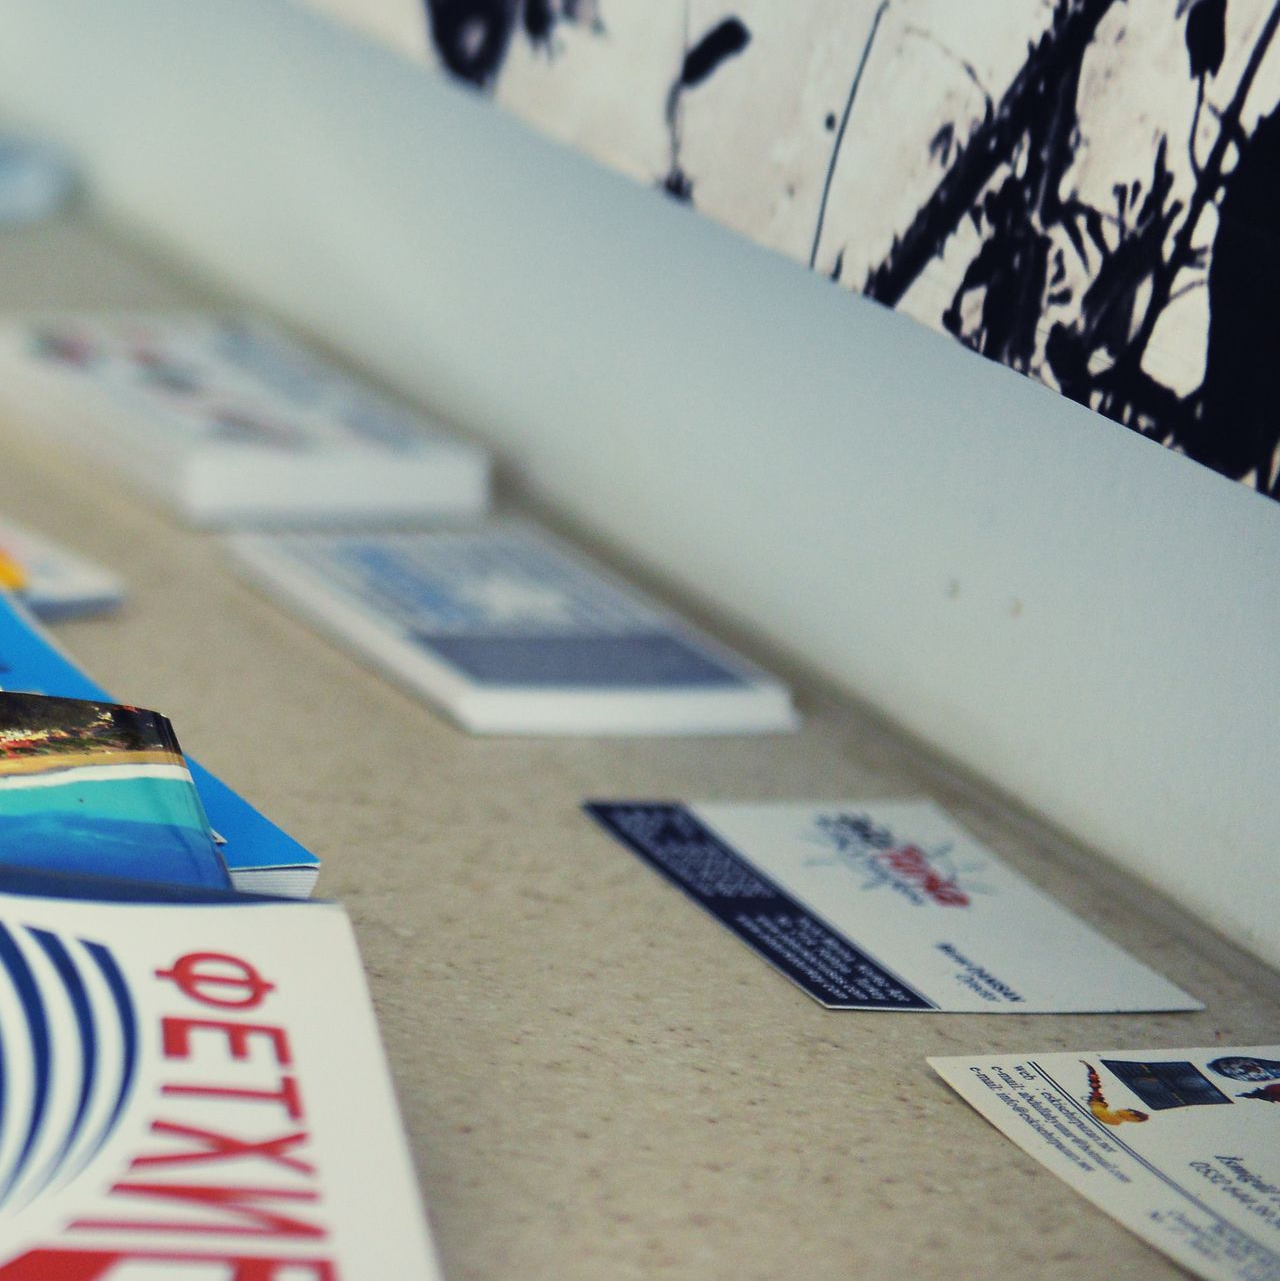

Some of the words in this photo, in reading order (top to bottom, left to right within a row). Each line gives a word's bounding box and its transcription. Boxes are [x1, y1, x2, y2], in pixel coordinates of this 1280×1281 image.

[969, 1066, 1003, 1092] e-mail:
[991, 1065, 1025, 1091] e-mail:
[1014, 1065, 1037, 1081] web
